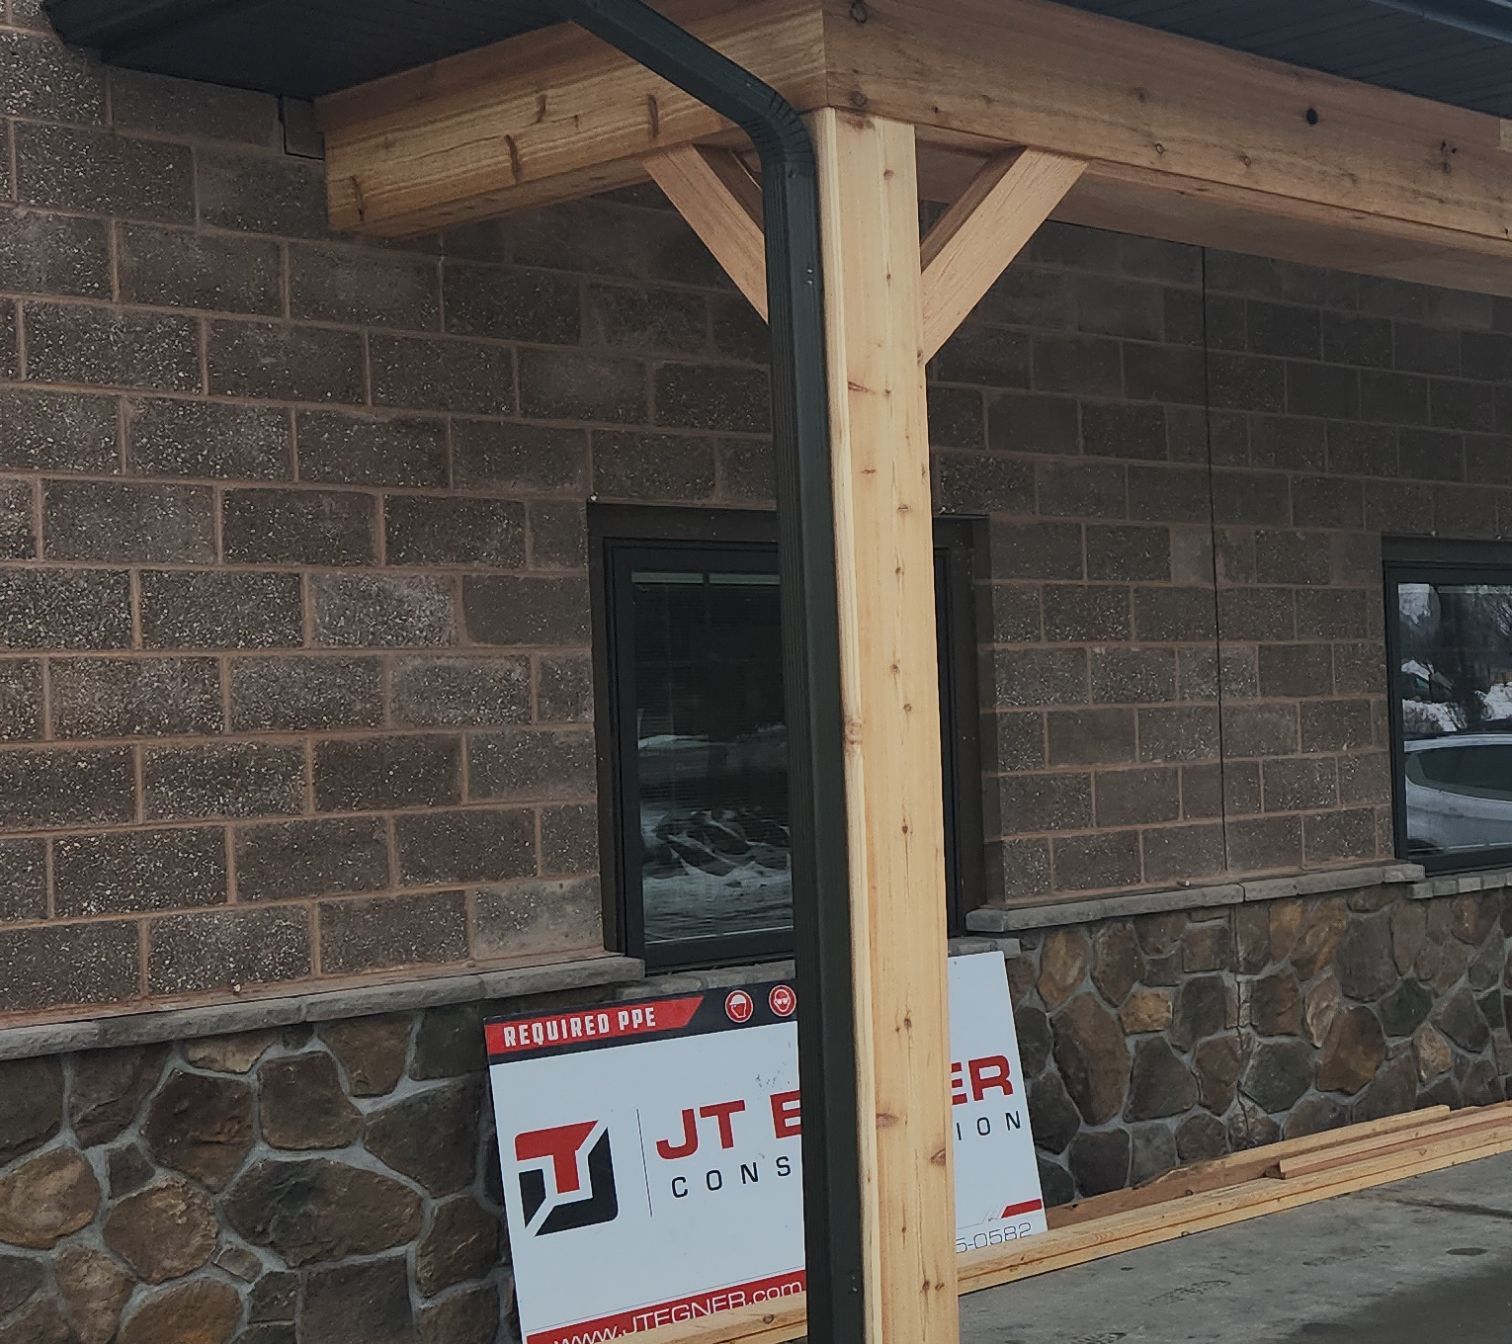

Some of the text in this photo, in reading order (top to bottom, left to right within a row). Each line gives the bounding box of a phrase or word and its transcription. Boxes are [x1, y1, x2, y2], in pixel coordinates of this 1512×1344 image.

[503, 1006, 657, 1047] REQUIRED PPE
[655, 1099, 746, 1161] JT
